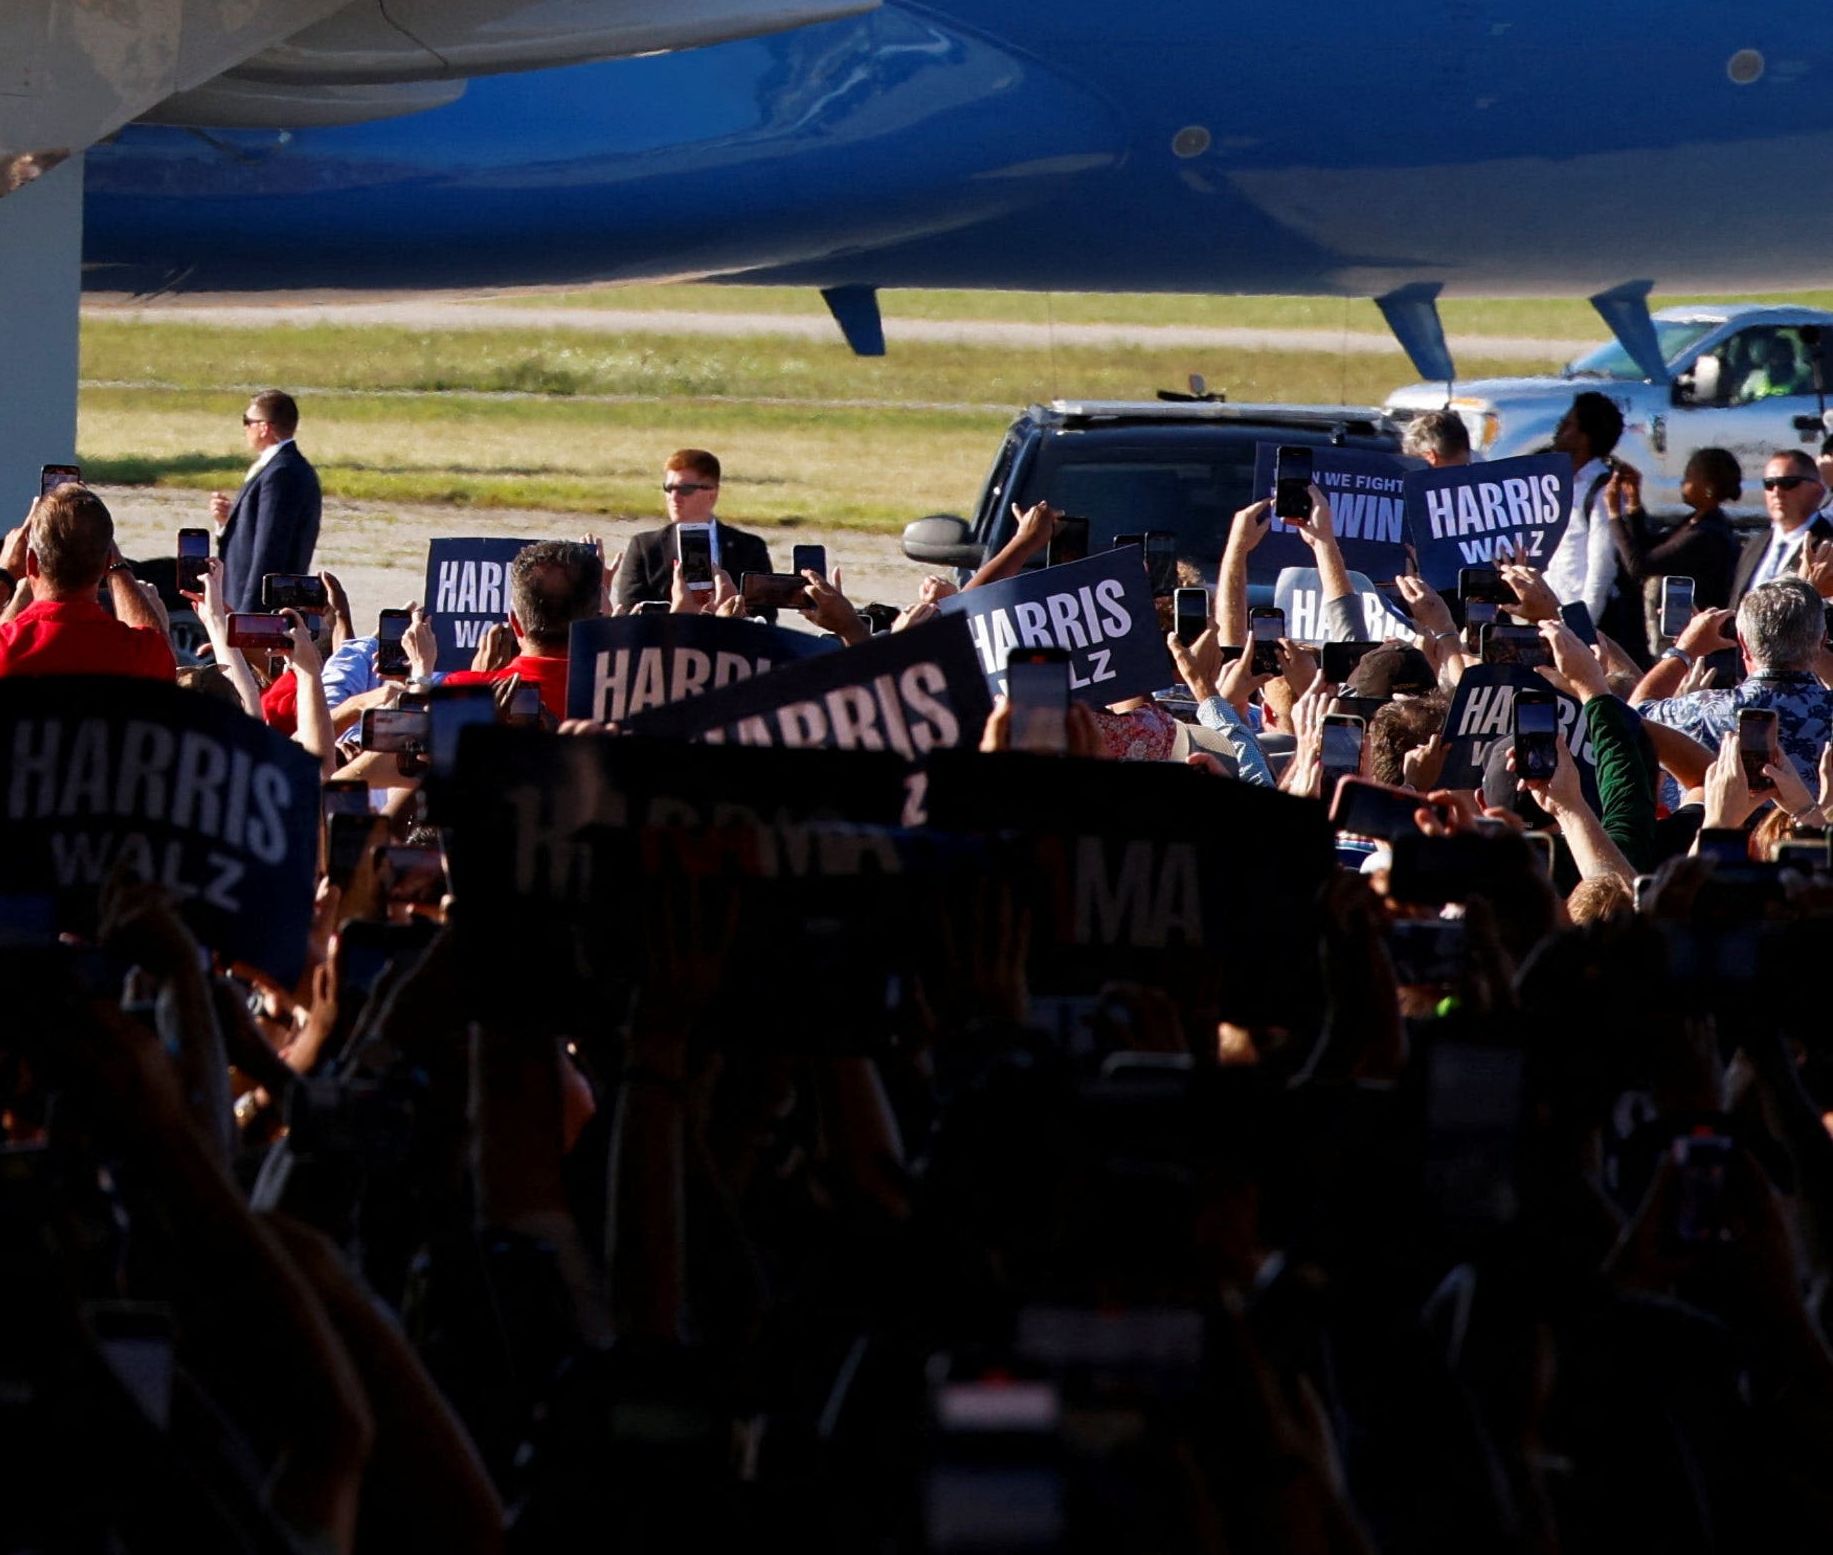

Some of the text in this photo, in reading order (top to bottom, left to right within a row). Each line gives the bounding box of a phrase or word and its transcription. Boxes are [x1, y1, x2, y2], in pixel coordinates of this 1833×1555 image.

[1324, 472, 1405, 493] WE FIGHT
[1426, 473, 1561, 540] HARRIS
[1329, 491, 1405, 544] WIN
[967, 578, 1133, 675] HARRIS
[7, 715, 293, 868] HARRIS
